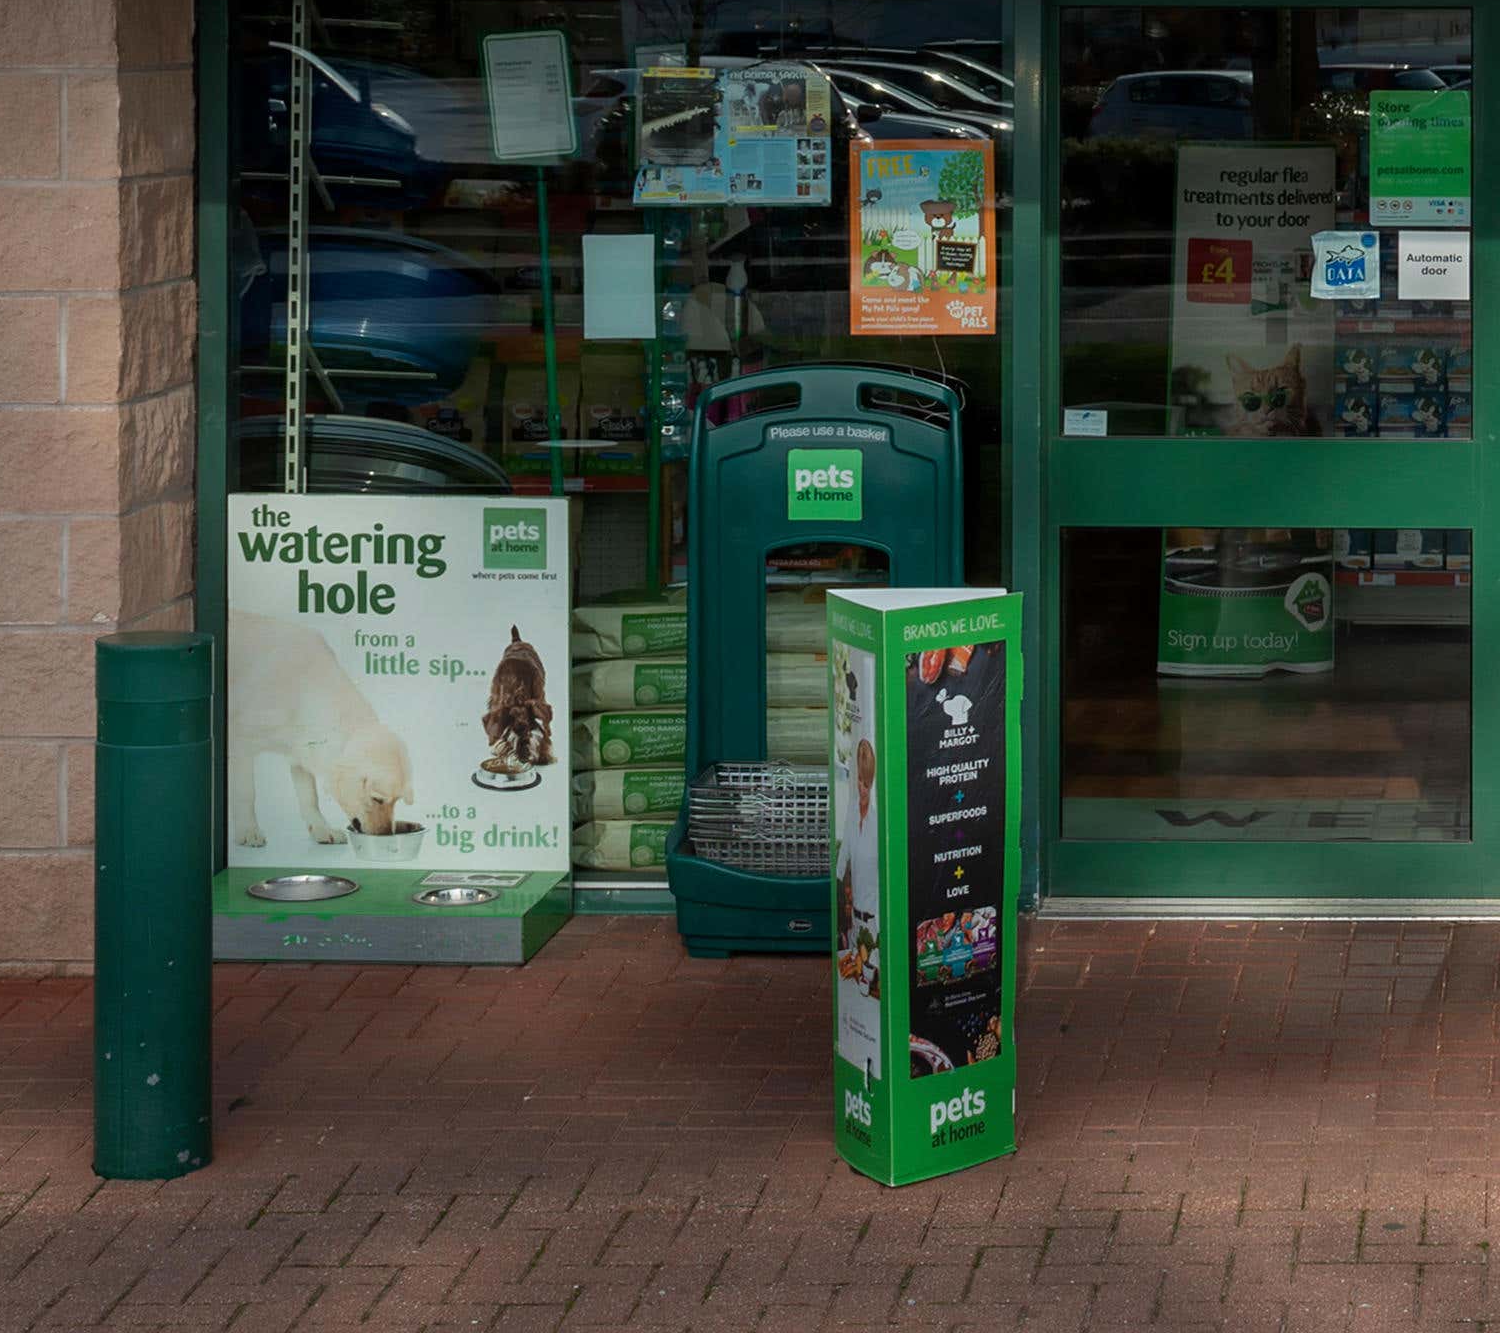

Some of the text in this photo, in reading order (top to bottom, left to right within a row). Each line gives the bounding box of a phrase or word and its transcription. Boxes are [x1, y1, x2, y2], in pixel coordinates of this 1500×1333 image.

[1377, 101, 1410, 113] Store
[1430, 115, 1464, 129] times
[867, 155, 917, 178] FREE
[1220, 166, 1308, 187] regular flea
[1183, 188, 1274, 206] treatments
[1217, 210, 1311, 230] to your door
[1406, 253, 1463, 263] Automatic
[1201, 255, 1237, 284] £4
[1421, 266, 1447, 276] door
[964, 305, 983, 318] PET
[961, 316, 988, 329] PALS
[770, 425, 888, 442] Please use a basket
[795, 464, 854, 492] pets
[796, 488, 853, 502] at home
[251, 504, 291, 528] the
[490, 520, 540, 544] pets
[238, 522, 448, 579] watering
[491, 540, 540, 553] at home
[472, 572, 558, 582] where pets come first
[298, 569, 396, 615] hole
[354, 629, 415, 648] from a
[902, 620, 948, 642] BRANDS
[950, 617, 967, 634] WE
[1167, 629, 1299, 652] Sign up today!
[365, 651, 487, 683] little sip...
[943, 726, 968, 740] BILLY
[926, 757, 990, 779] HIGH QUALITY
[939, 771, 978, 787] PROTEIN
[467, 806, 477, 820] a
[928, 805, 988, 826] SUPERFOODS
[436, 822, 559, 854] big drink!
[933, 844, 983, 864] NUTRITION
[947, 883, 970, 898] LOVE
[844, 1088, 872, 1127] pets
[930, 1086, 986, 1135] pets
[931, 1119, 986, 1148] at home
